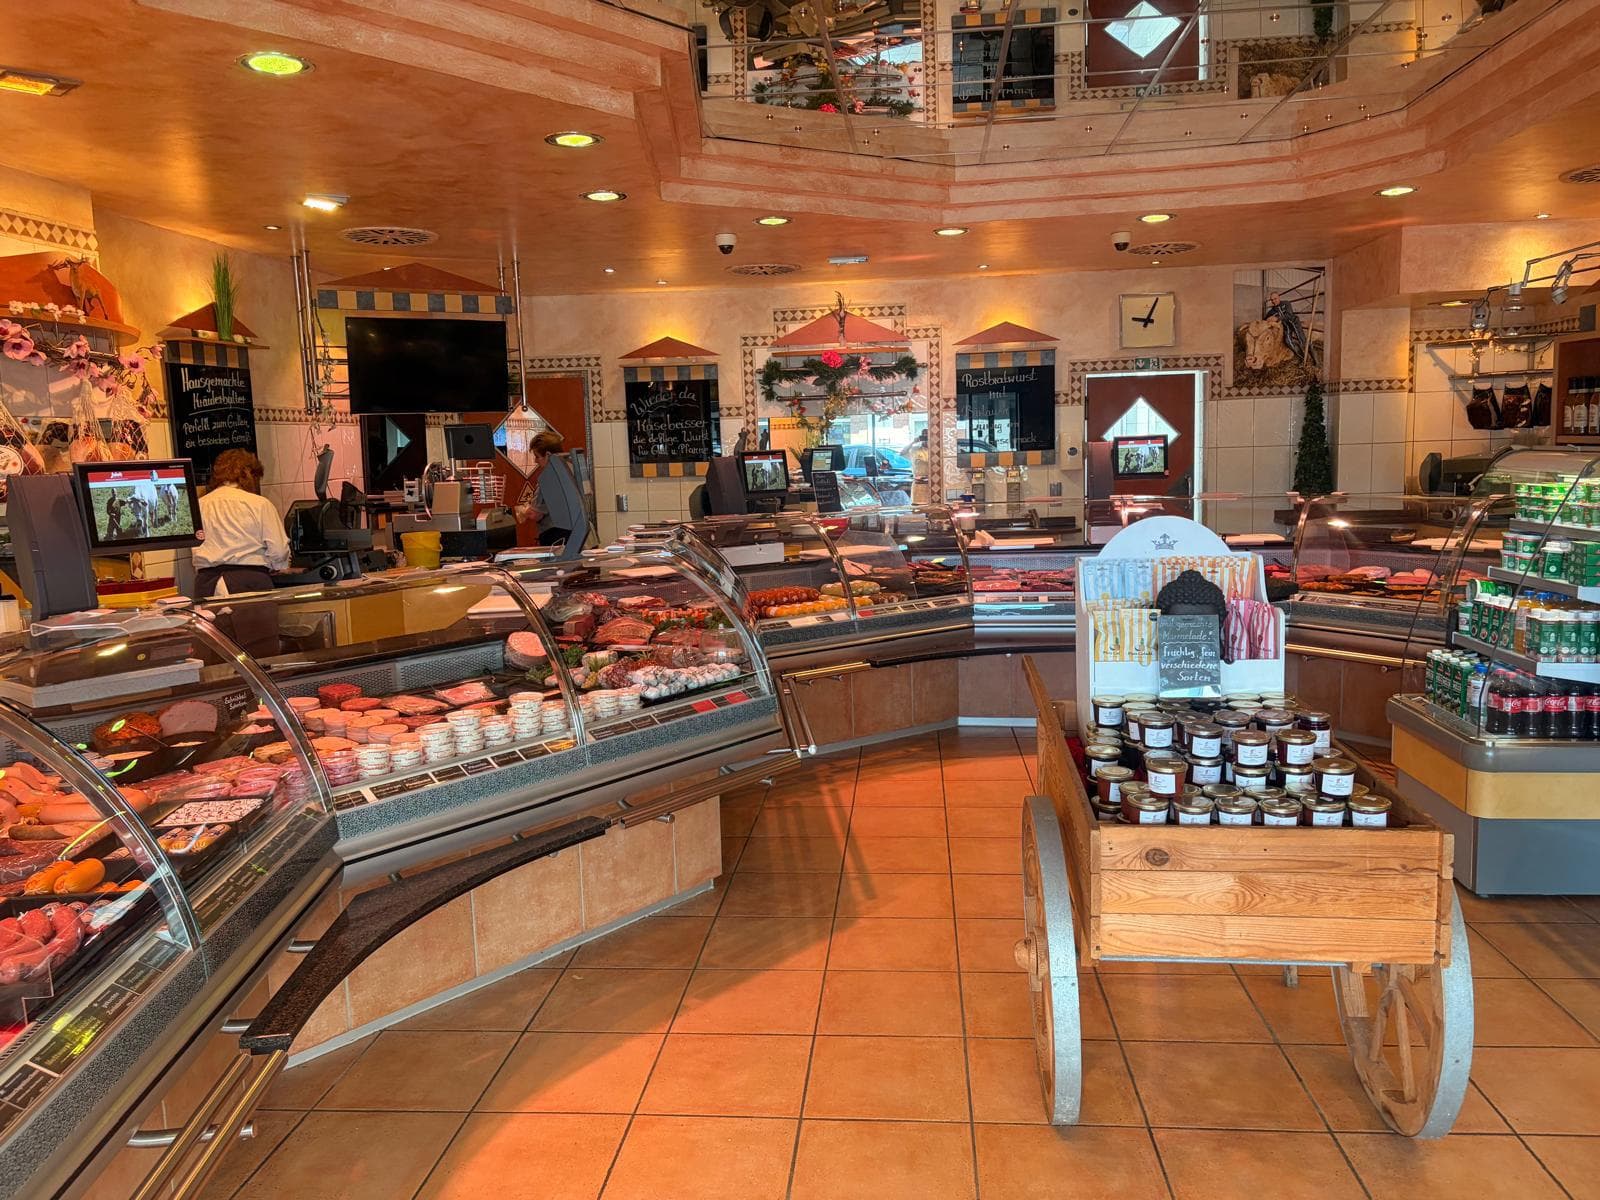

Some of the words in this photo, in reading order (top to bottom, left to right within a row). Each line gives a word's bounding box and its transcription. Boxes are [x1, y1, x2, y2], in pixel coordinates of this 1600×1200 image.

[962, 368, 1038, 388] Rostbratwurst
[1160, 660, 1218, 670] verschiedene
[1177, 671, 1211, 682] Sorten
